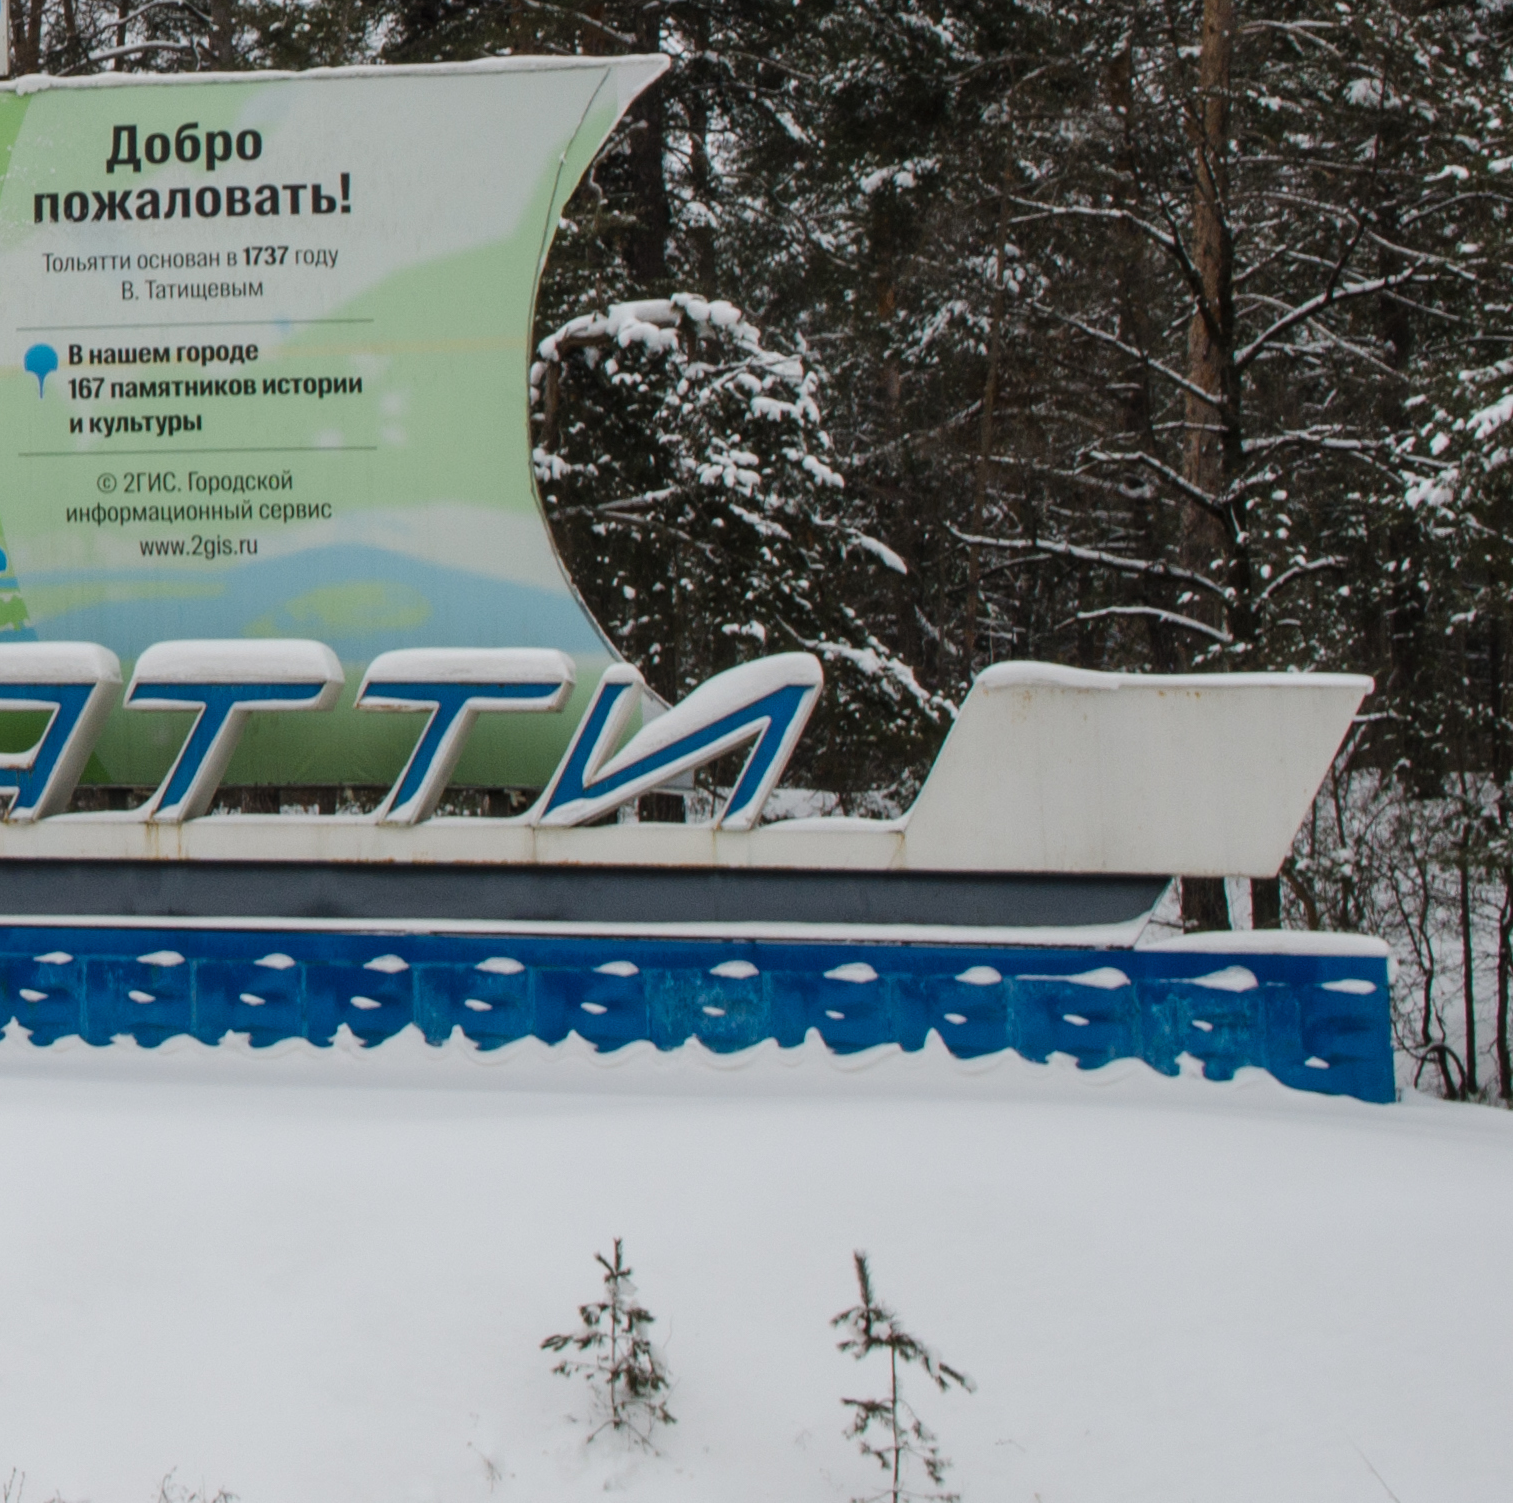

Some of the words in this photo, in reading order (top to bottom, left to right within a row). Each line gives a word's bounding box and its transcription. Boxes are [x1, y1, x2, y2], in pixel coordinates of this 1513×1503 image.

[106, 122, 262, 174] Добро
[34, 172, 351, 223] пожаловать!
[43, 253, 131, 272] Тольятти
[137, 250, 220, 269] основан
[227, 251, 237, 266] в
[242, 246, 289, 266] 1737
[295, 248, 338, 268] году
[121, 281, 139, 300] В.
[145, 279, 264, 301] Татищевым
[68, 345, 83, 365] В
[89, 347, 171, 365] нашем
[176, 344, 259, 366] городе
[69, 377, 105, 399] 167
[111, 379, 257, 399] памятников
[263, 377, 363, 399] истории
[69, 417, 83, 433] и
[89, 415, 202, 437] культуры
[123, 472, 181, 493] 2ГИС.
[188, 470, 293, 495] Городской
[66, 499, 253, 526] информационный
[259, 502, 332, 523] сервис
[140, 534, 258, 559] www.2gis.ru
